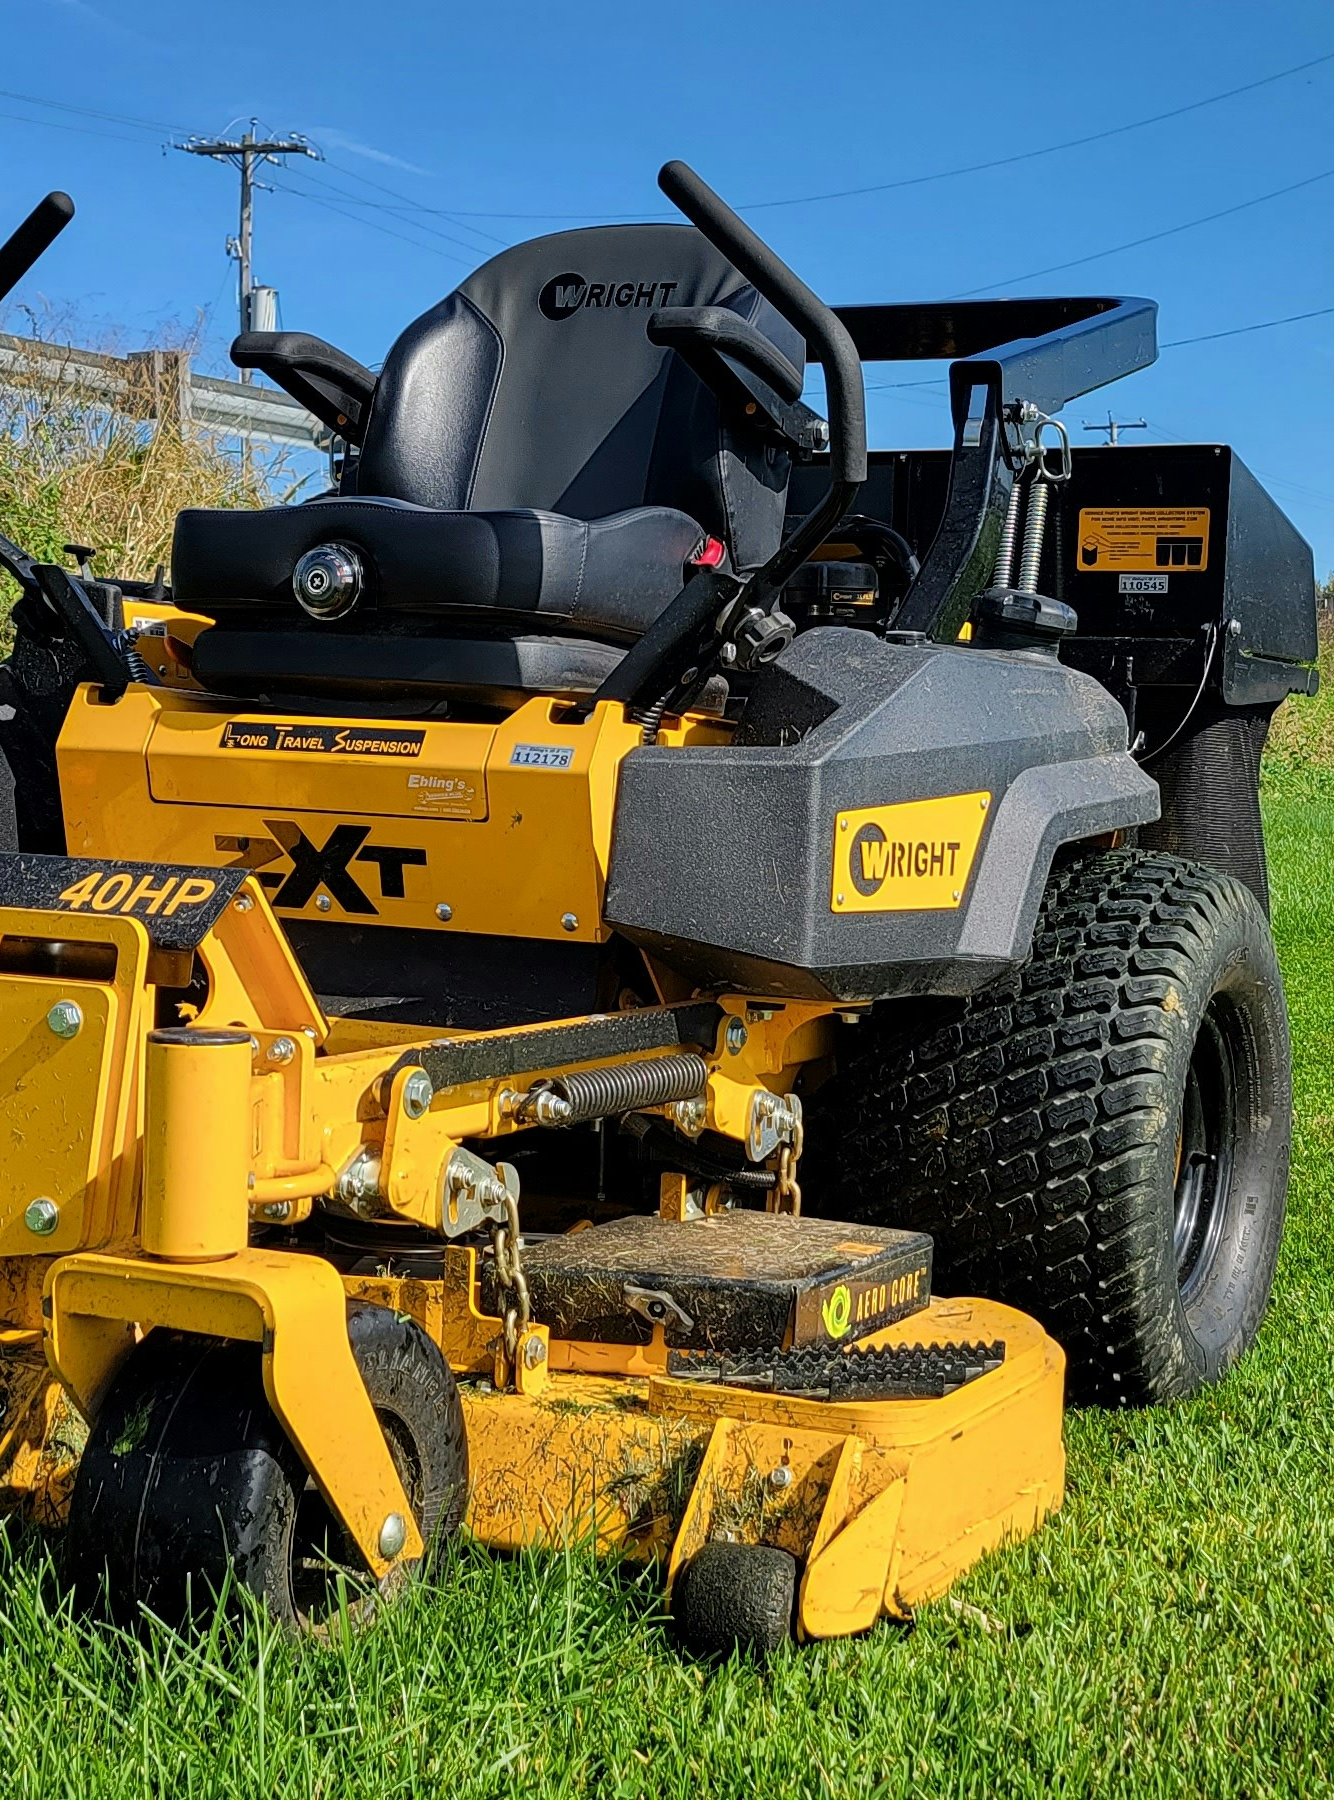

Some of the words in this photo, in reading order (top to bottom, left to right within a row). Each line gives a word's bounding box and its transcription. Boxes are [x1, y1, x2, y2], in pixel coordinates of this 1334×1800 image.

[554, 281, 680, 308] WRIGHT
[1122, 581, 1165, 591] 110545
[225, 724, 269, 748] LONG
[275, 726, 325, 750] TRAVEL
[331, 729, 421, 754] SUSPENSION
[514, 751, 569, 765] 112178
[408, 774, 466, 791] Ebling's
[860, 841, 961, 879] WRIGHT
[59, 872, 216, 916] 40HP
[857, 1284, 886, 1322] AERO
